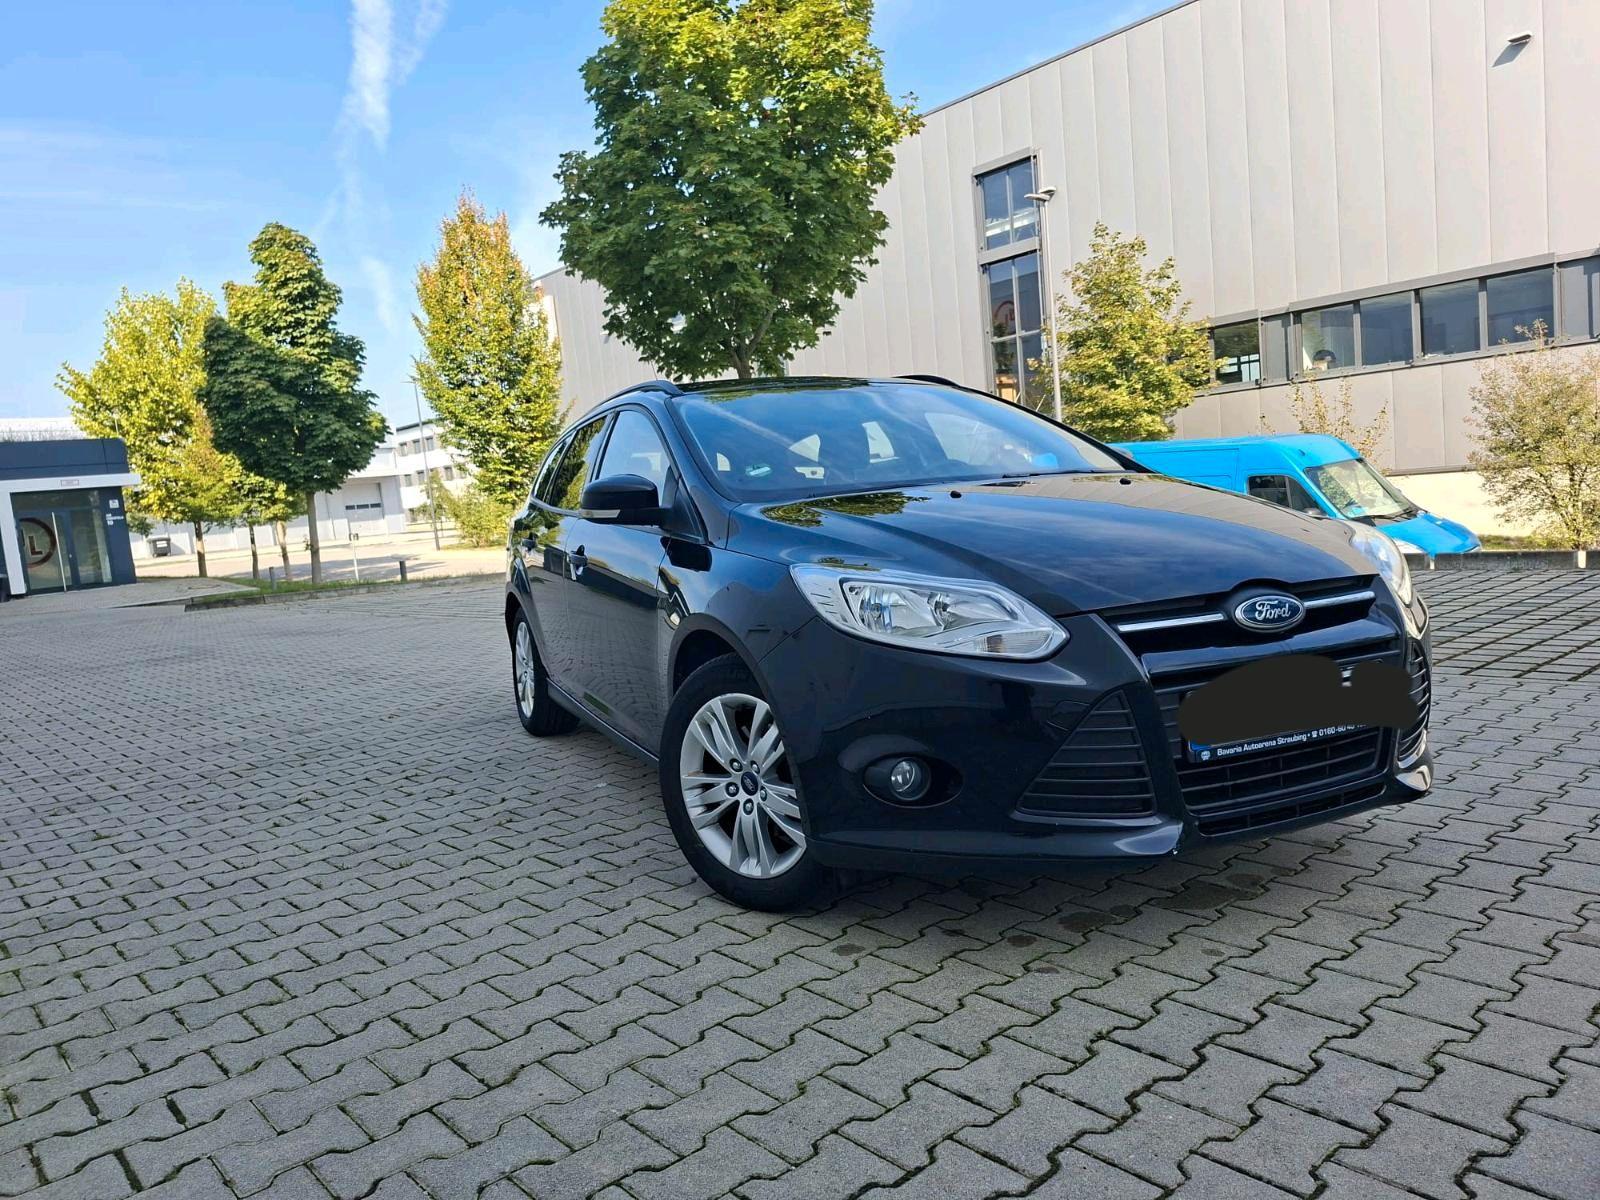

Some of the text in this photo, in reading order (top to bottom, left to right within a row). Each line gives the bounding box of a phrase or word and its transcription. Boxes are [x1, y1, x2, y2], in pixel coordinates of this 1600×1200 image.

[1255, 600, 1291, 621] Ford
[1217, 746, 1242, 756] Bavaria
[1243, 740, 1276, 751] Autoarena
[1277, 733, 1307, 745] Straubing
